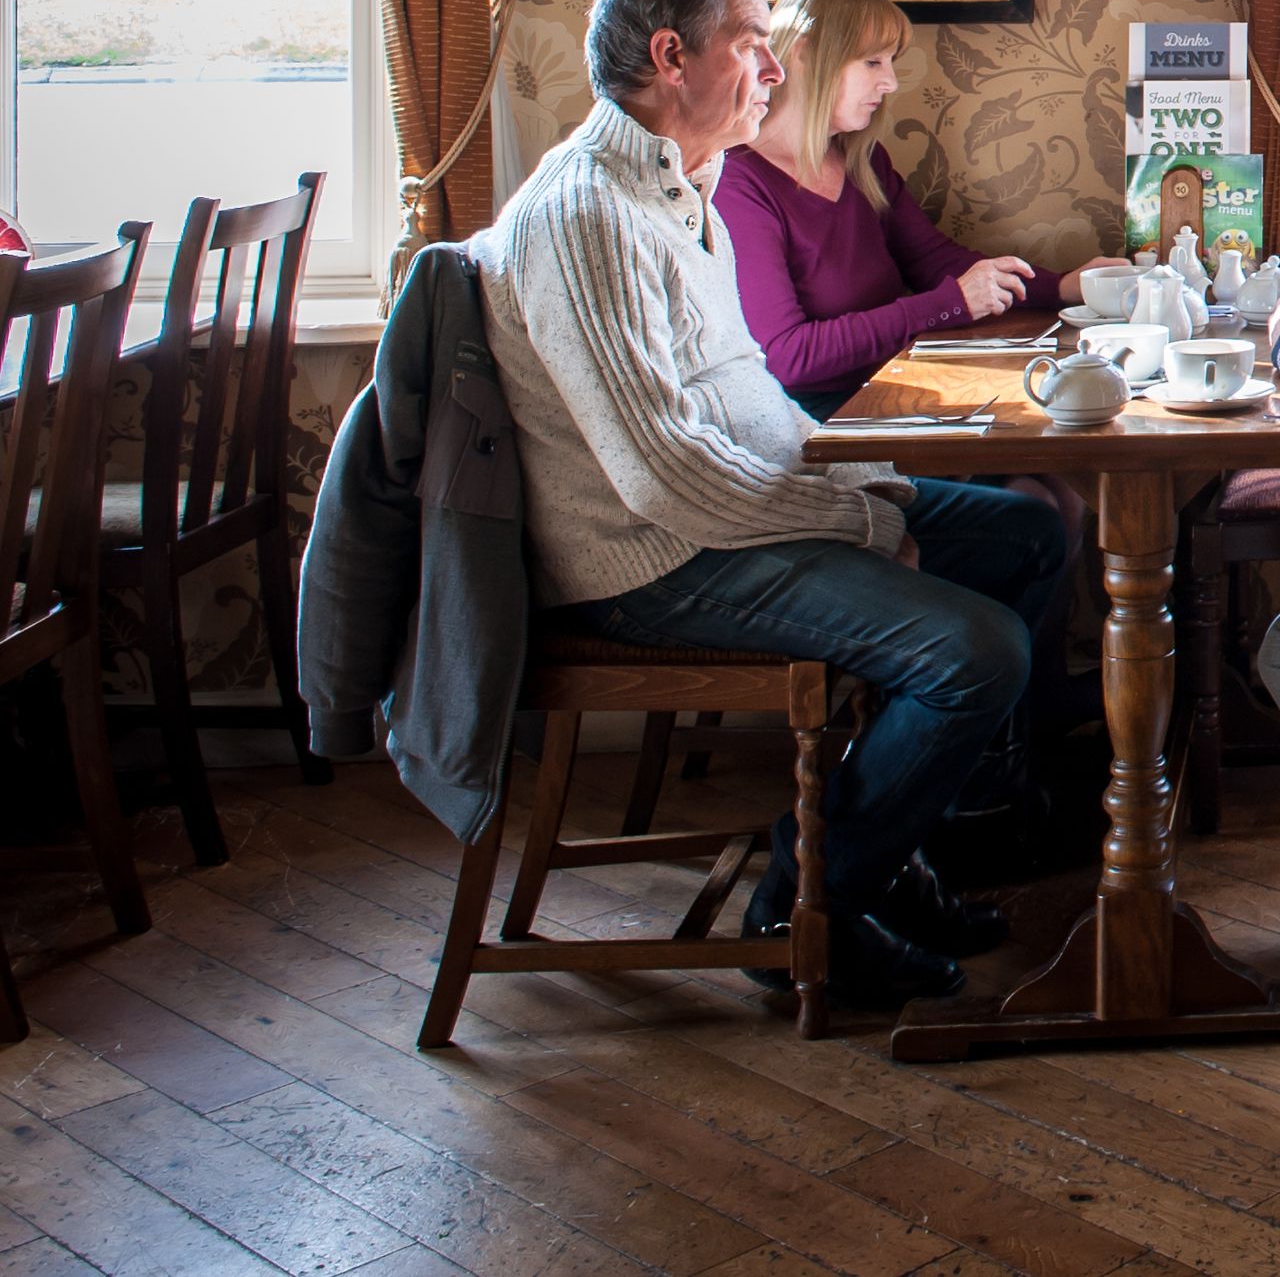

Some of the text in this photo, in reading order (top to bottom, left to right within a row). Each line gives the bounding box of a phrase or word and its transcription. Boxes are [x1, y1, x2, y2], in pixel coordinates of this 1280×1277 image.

[1163, 32, 1213, 47] Drinks
[1150, 50, 1225, 68] MENU
[1149, 91, 1224, 104] Food Menu
[1150, 107, 1224, 130] TWO
[1174, 131, 1200, 140] FOR
[1218, 205, 1253, 216] menu
